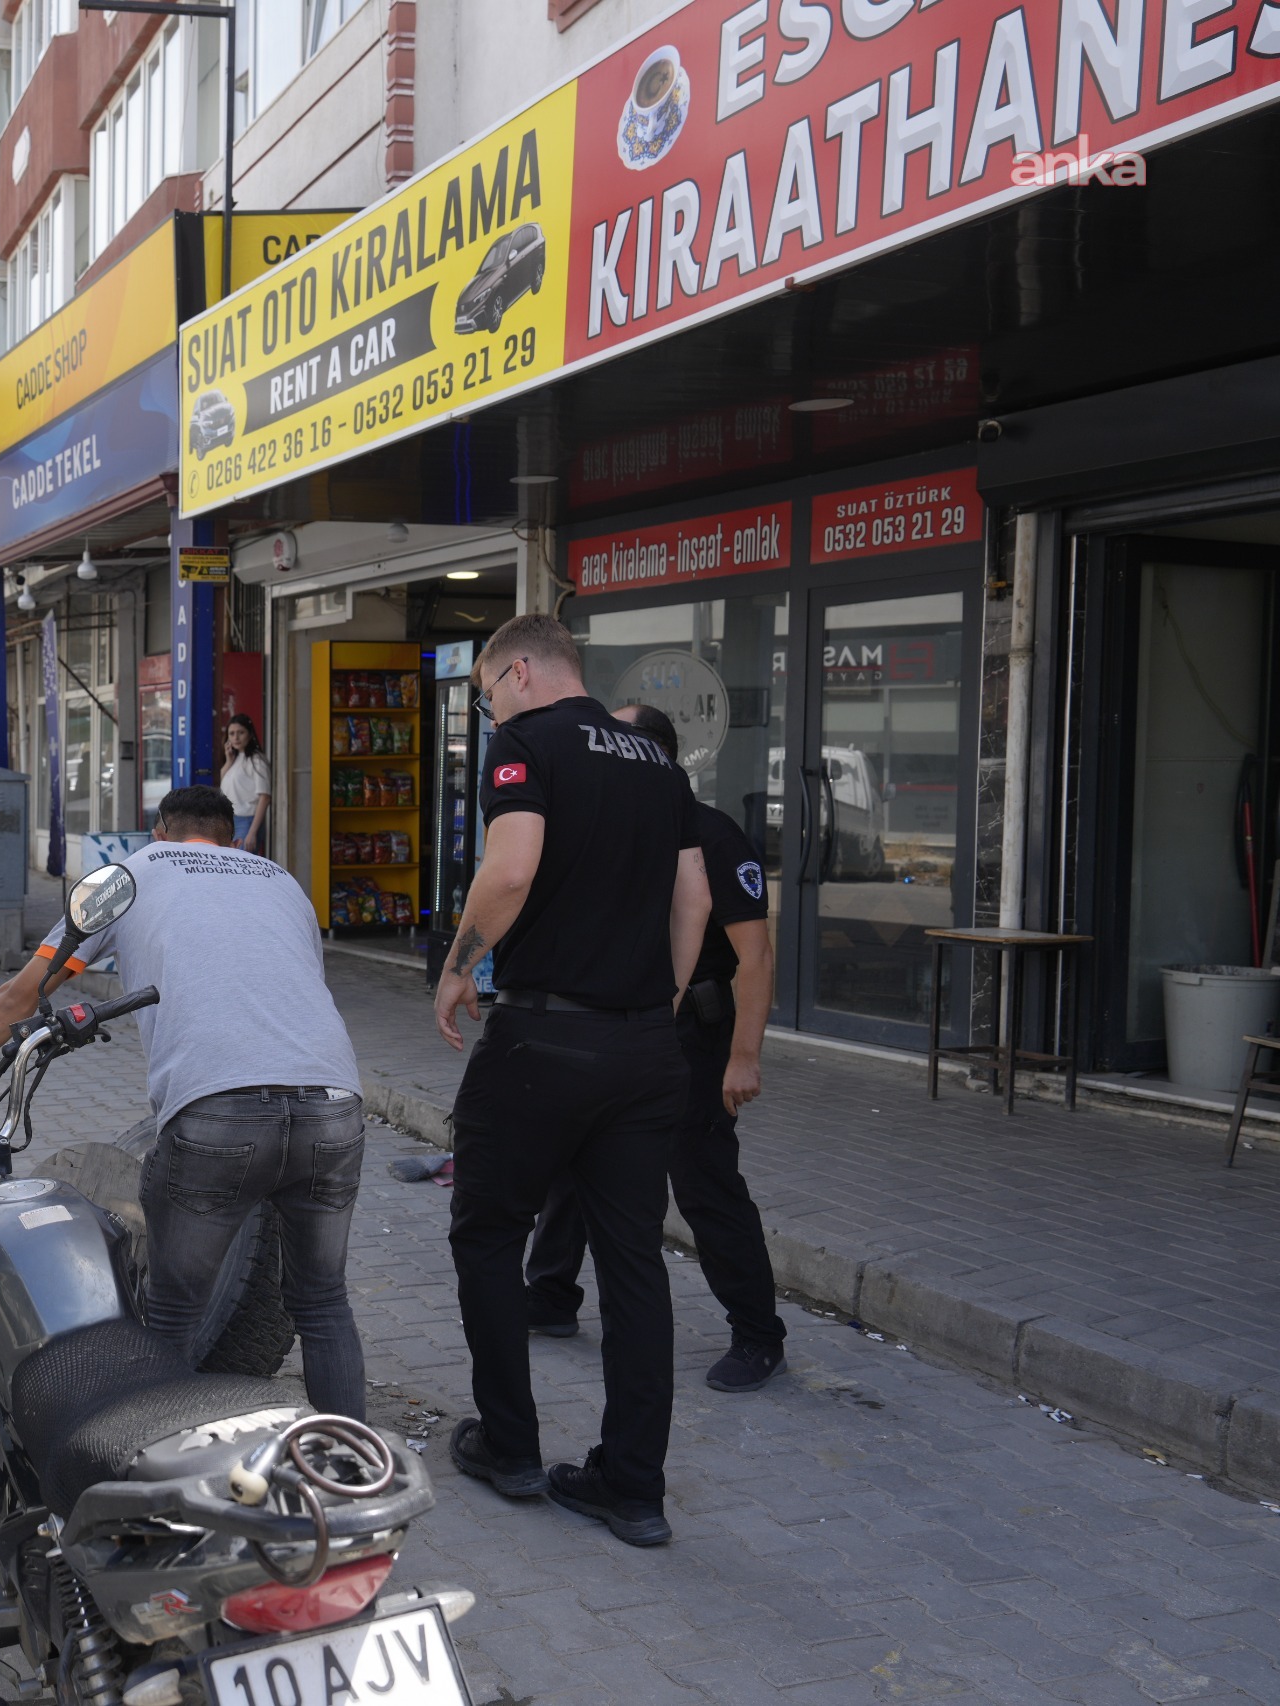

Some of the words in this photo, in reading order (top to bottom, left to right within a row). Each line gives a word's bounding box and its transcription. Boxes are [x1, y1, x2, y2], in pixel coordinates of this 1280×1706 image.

[187, 305, 253, 394] SUAT
[261, 267, 317, 356] OTO
[269, 355, 321, 414] RENT
[327, 349, 342, 389] A
[349, 317, 396, 378] CAR
[16, 354, 53, 410] CADDE
[54, 328, 87, 382] SHOP
[206, 453, 242, 492] 0266
[247, 440, 277, 475] 422
[282, 432, 304, 462] 36
[311, 421, 332, 452] 16
[353, 385, 405, 436] 0532
[411, 361, 454, 412] 053
[463, 347, 493, 390] 21
[504, 327, 536, 370] 29
[12, 456, 54, 509] CADDE
[55, 434, 101, 486] TEKEL
[836, 497, 878, 518] SUAT
[884, 485, 952, 513] ÖZTÜRK
[582, 553, 608, 591] araç
[611, 530, 667, 583] kiralama
[733, 515, 780, 565] emlak
[824, 521, 867, 553] 0532
[871, 515, 906, 546] 053
[911, 513, 935, 541] 21
[941, 506, 965, 536] 29
[578, 724, 673, 770] ZABITA
[148, 850, 218, 862] BURHANİYE
[233, 1657, 301, 1706] 10
